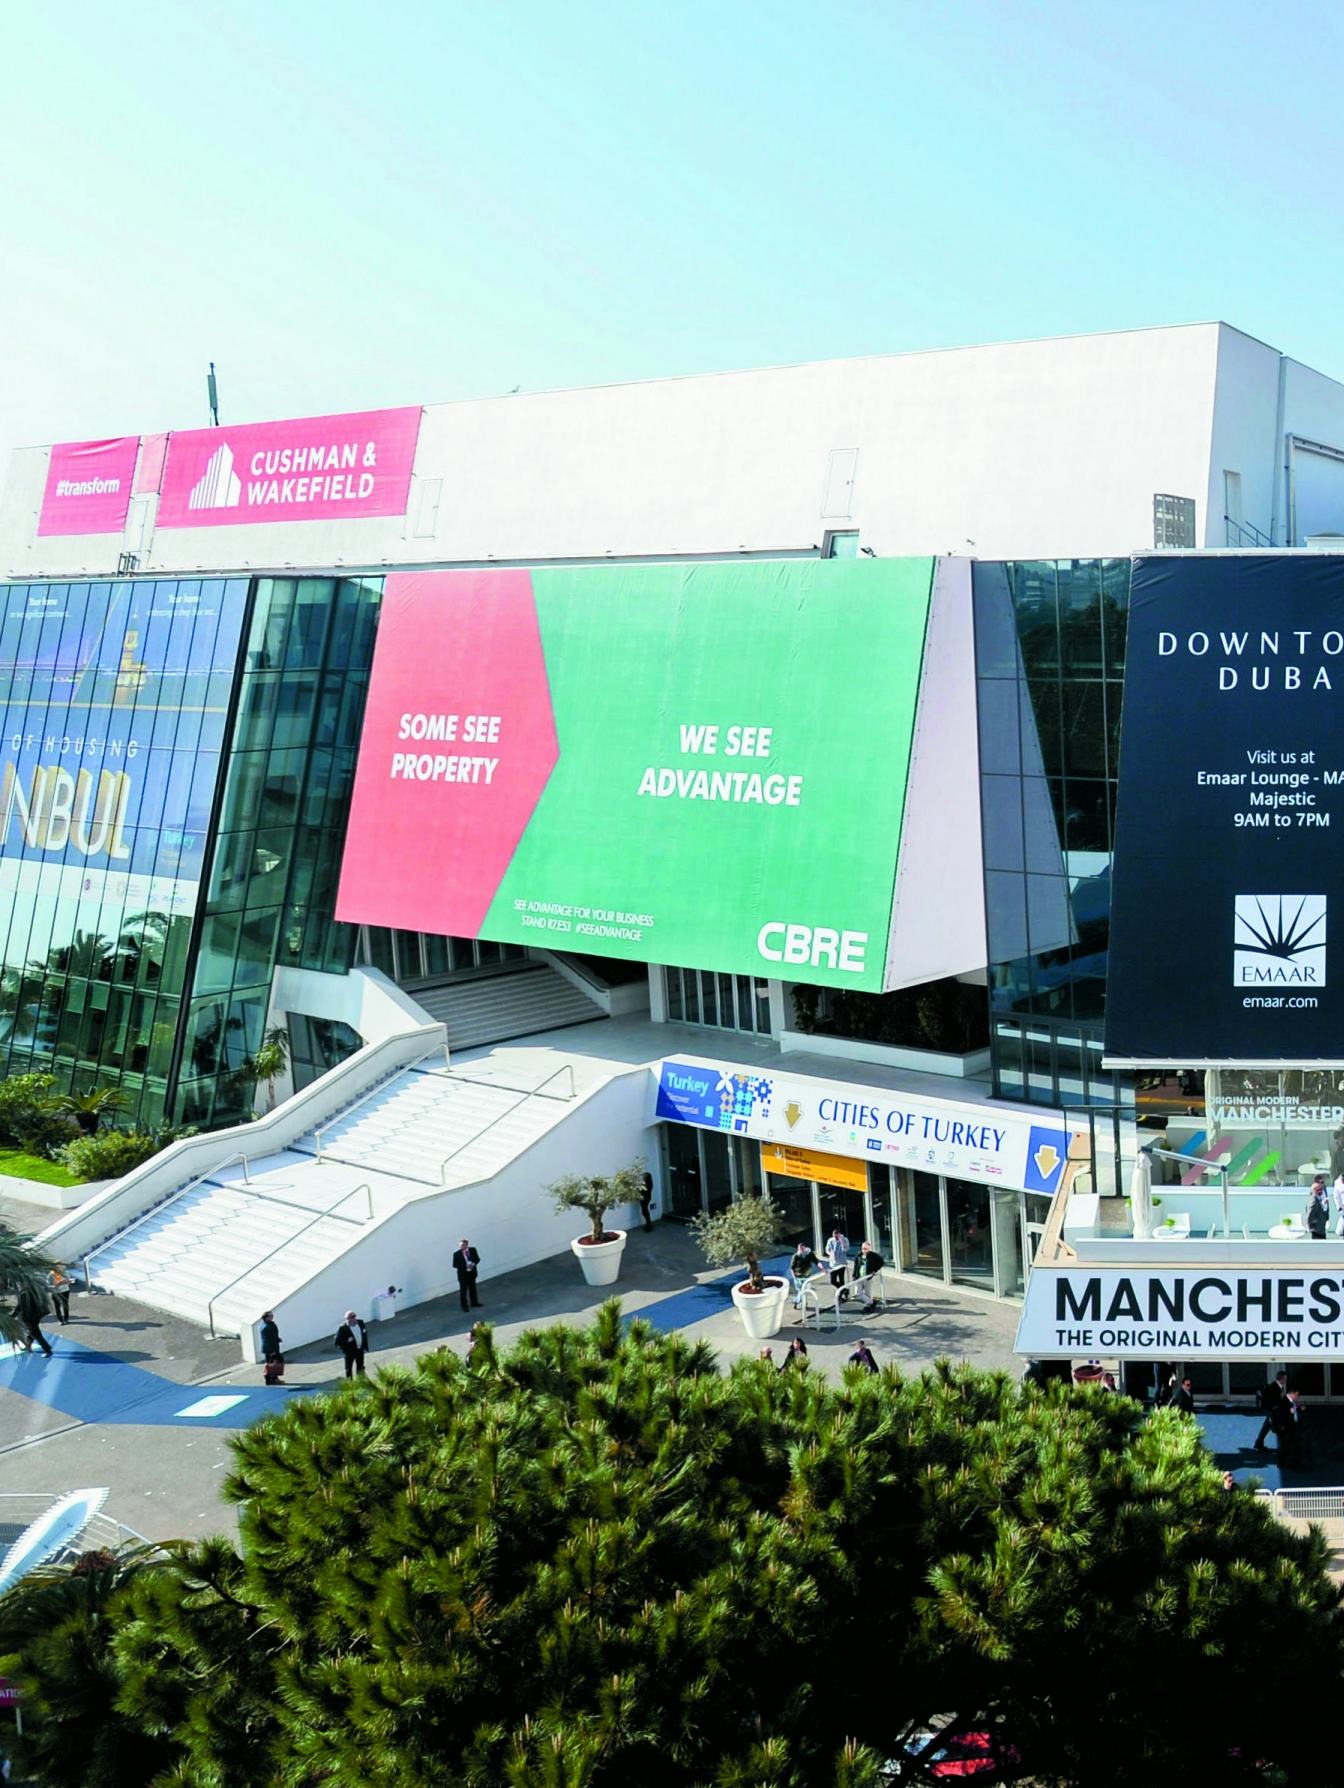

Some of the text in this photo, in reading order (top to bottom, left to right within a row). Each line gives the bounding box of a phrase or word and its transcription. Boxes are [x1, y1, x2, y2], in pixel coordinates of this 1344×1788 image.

[251, 442, 376, 476] CUSHMAN &
[56, 476, 119, 497] #transform
[248, 473, 374, 506] WAKEFIELD
[398, 714, 501, 744] SOME SEE
[679, 724, 772, 757] WE SEE
[12, 734, 138, 758] OF HOUSING
[1247, 750, 1315, 764] Visit us at
[390, 753, 499, 784] PROPERTY
[1197, 771, 1247, 785] Emaar
[1251, 771, 1310, 789] Lounge
[638, 768, 803, 806] ADVANTAGE
[1249, 791, 1316, 809] Majestic
[1234, 813, 1330, 827] 9AM to 7PM
[513, 898, 654, 927] SEE ADVANTAGE FOR YOUR BUSINESS
[521, 914, 547, 929] STAND
[575, 922, 642, 942] #SEEADVANTAGE
[757, 921, 868, 973] CBRE
[1242, 966, 1317, 982] EMAAR
[1242, 996, 1318, 1009] emaar.com
[667, 1071, 709, 1098] Turkey
[1209, 1096, 1299, 1106] ORIGINAL MODERN
[1210, 1106, 1344, 1121] MANCHESTER
[818, 1098, 1006, 1152] CITIES OF TURKEY
[1056, 1329, 1093, 1346] THE
[1099, 1329, 1202, 1347] ORIGINAL
[1208, 1330, 1301, 1348] MODERN
